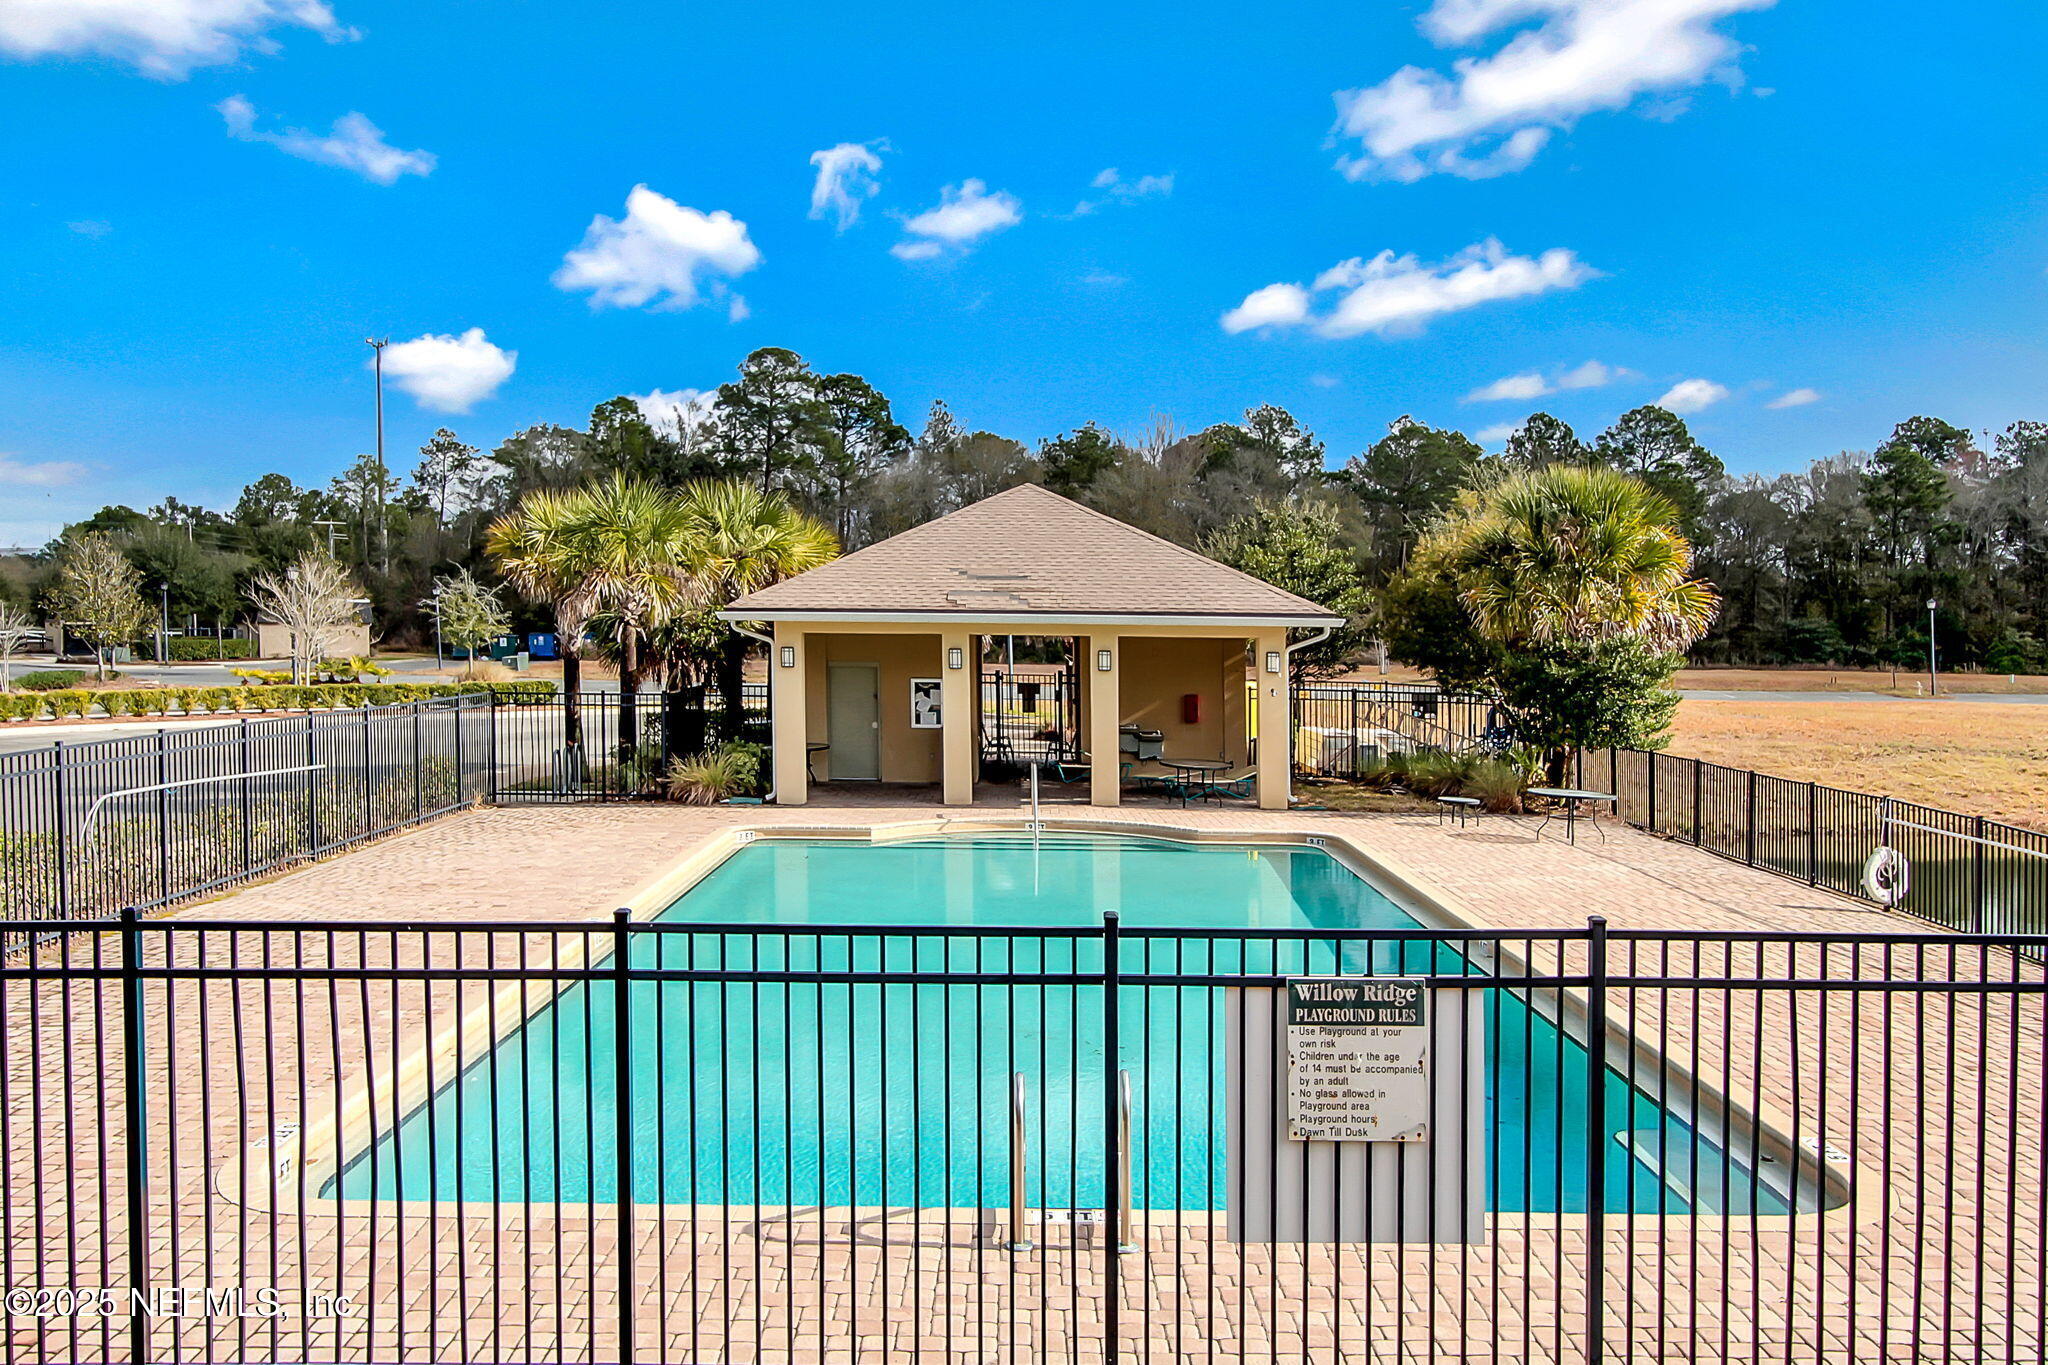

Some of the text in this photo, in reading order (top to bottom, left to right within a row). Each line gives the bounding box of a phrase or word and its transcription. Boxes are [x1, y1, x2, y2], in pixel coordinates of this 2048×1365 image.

[1295, 983, 1417, 1006] Willow Ridge
[1295, 1008, 1416, 1023] PLAYGROUND RULES
[1299, 1027, 1402, 1038] Use Playground at your
[1299, 1039, 1336, 1048] own risk
[1300, 1051, 1400, 1063] Children undr the age
[1299, 1064, 1424, 1075] of 14 must be accompanied
[1299, 1077, 1309, 1087] by
[1327, 1077, 1349, 1085] adult
[1300, 1089, 1386, 1099] No glass allowed in
[1300, 1102, 1347, 1112] Playground
[1300, 1114, 1347, 1125] Playground
[1300, 1128, 1368, 1136] Dawn Till Dusk
